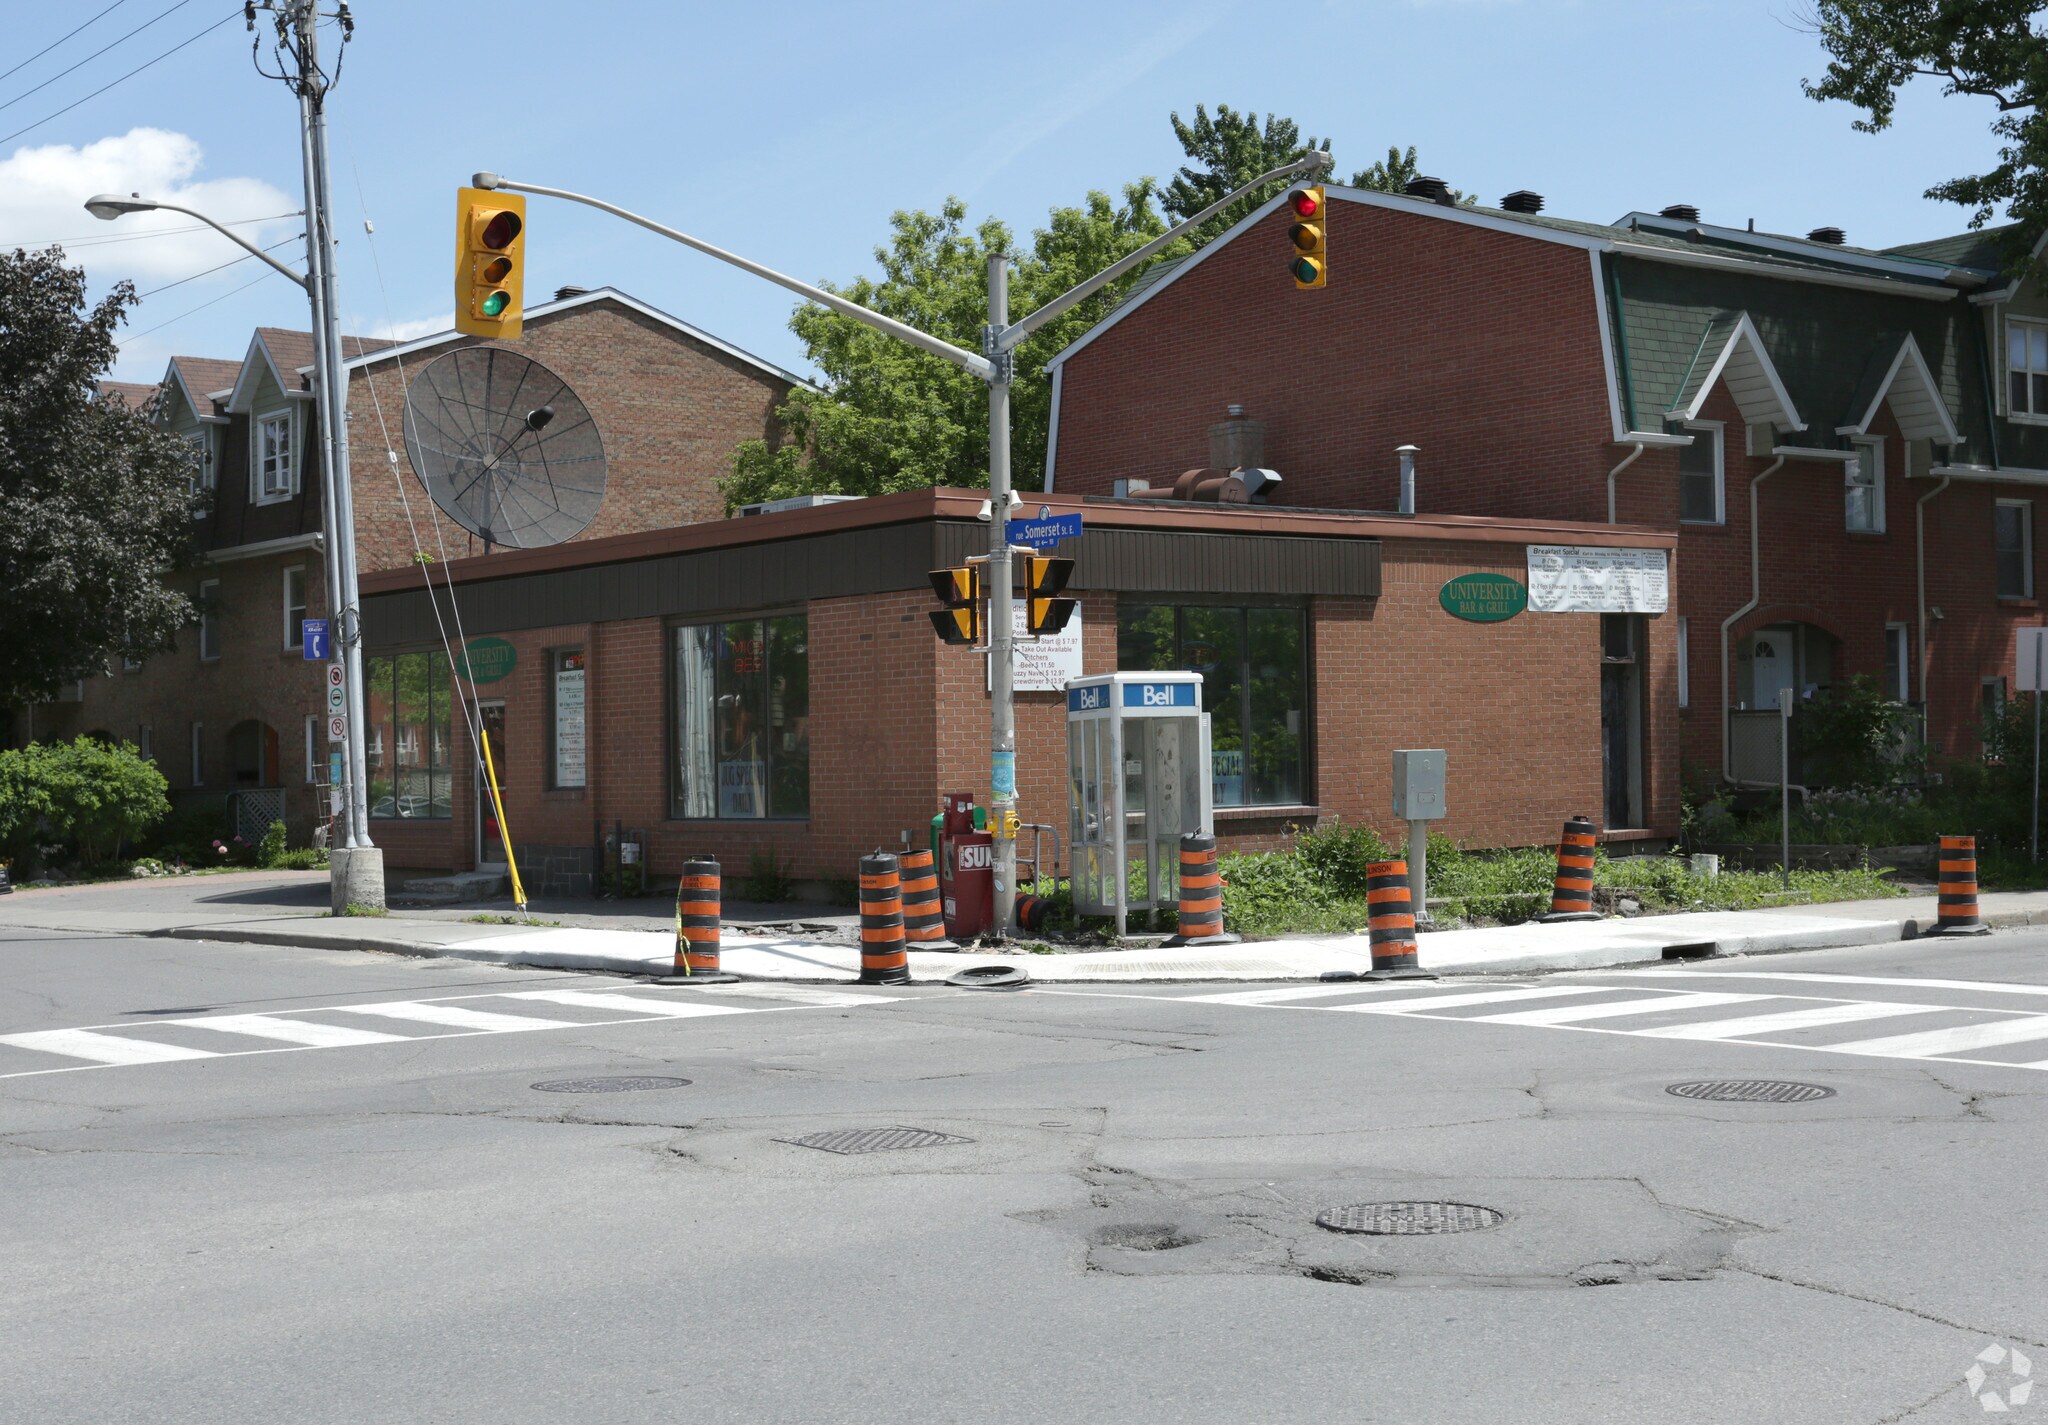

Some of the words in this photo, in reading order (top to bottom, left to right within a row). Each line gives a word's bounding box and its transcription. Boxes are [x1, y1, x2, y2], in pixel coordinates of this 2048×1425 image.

[1025, 522, 1060, 539] Somerset
[1449, 582, 1520, 600] UNIVERSITY
[1460, 601, 1476, 613] BAR
[1479, 603, 1485, 613] &
[1486, 601, 1509, 613] GRILL
[1080, 687, 1099, 709] Bell
[1143, 685, 1175, 706] Bell
[1212, 756, 1242, 776] PECIAL
